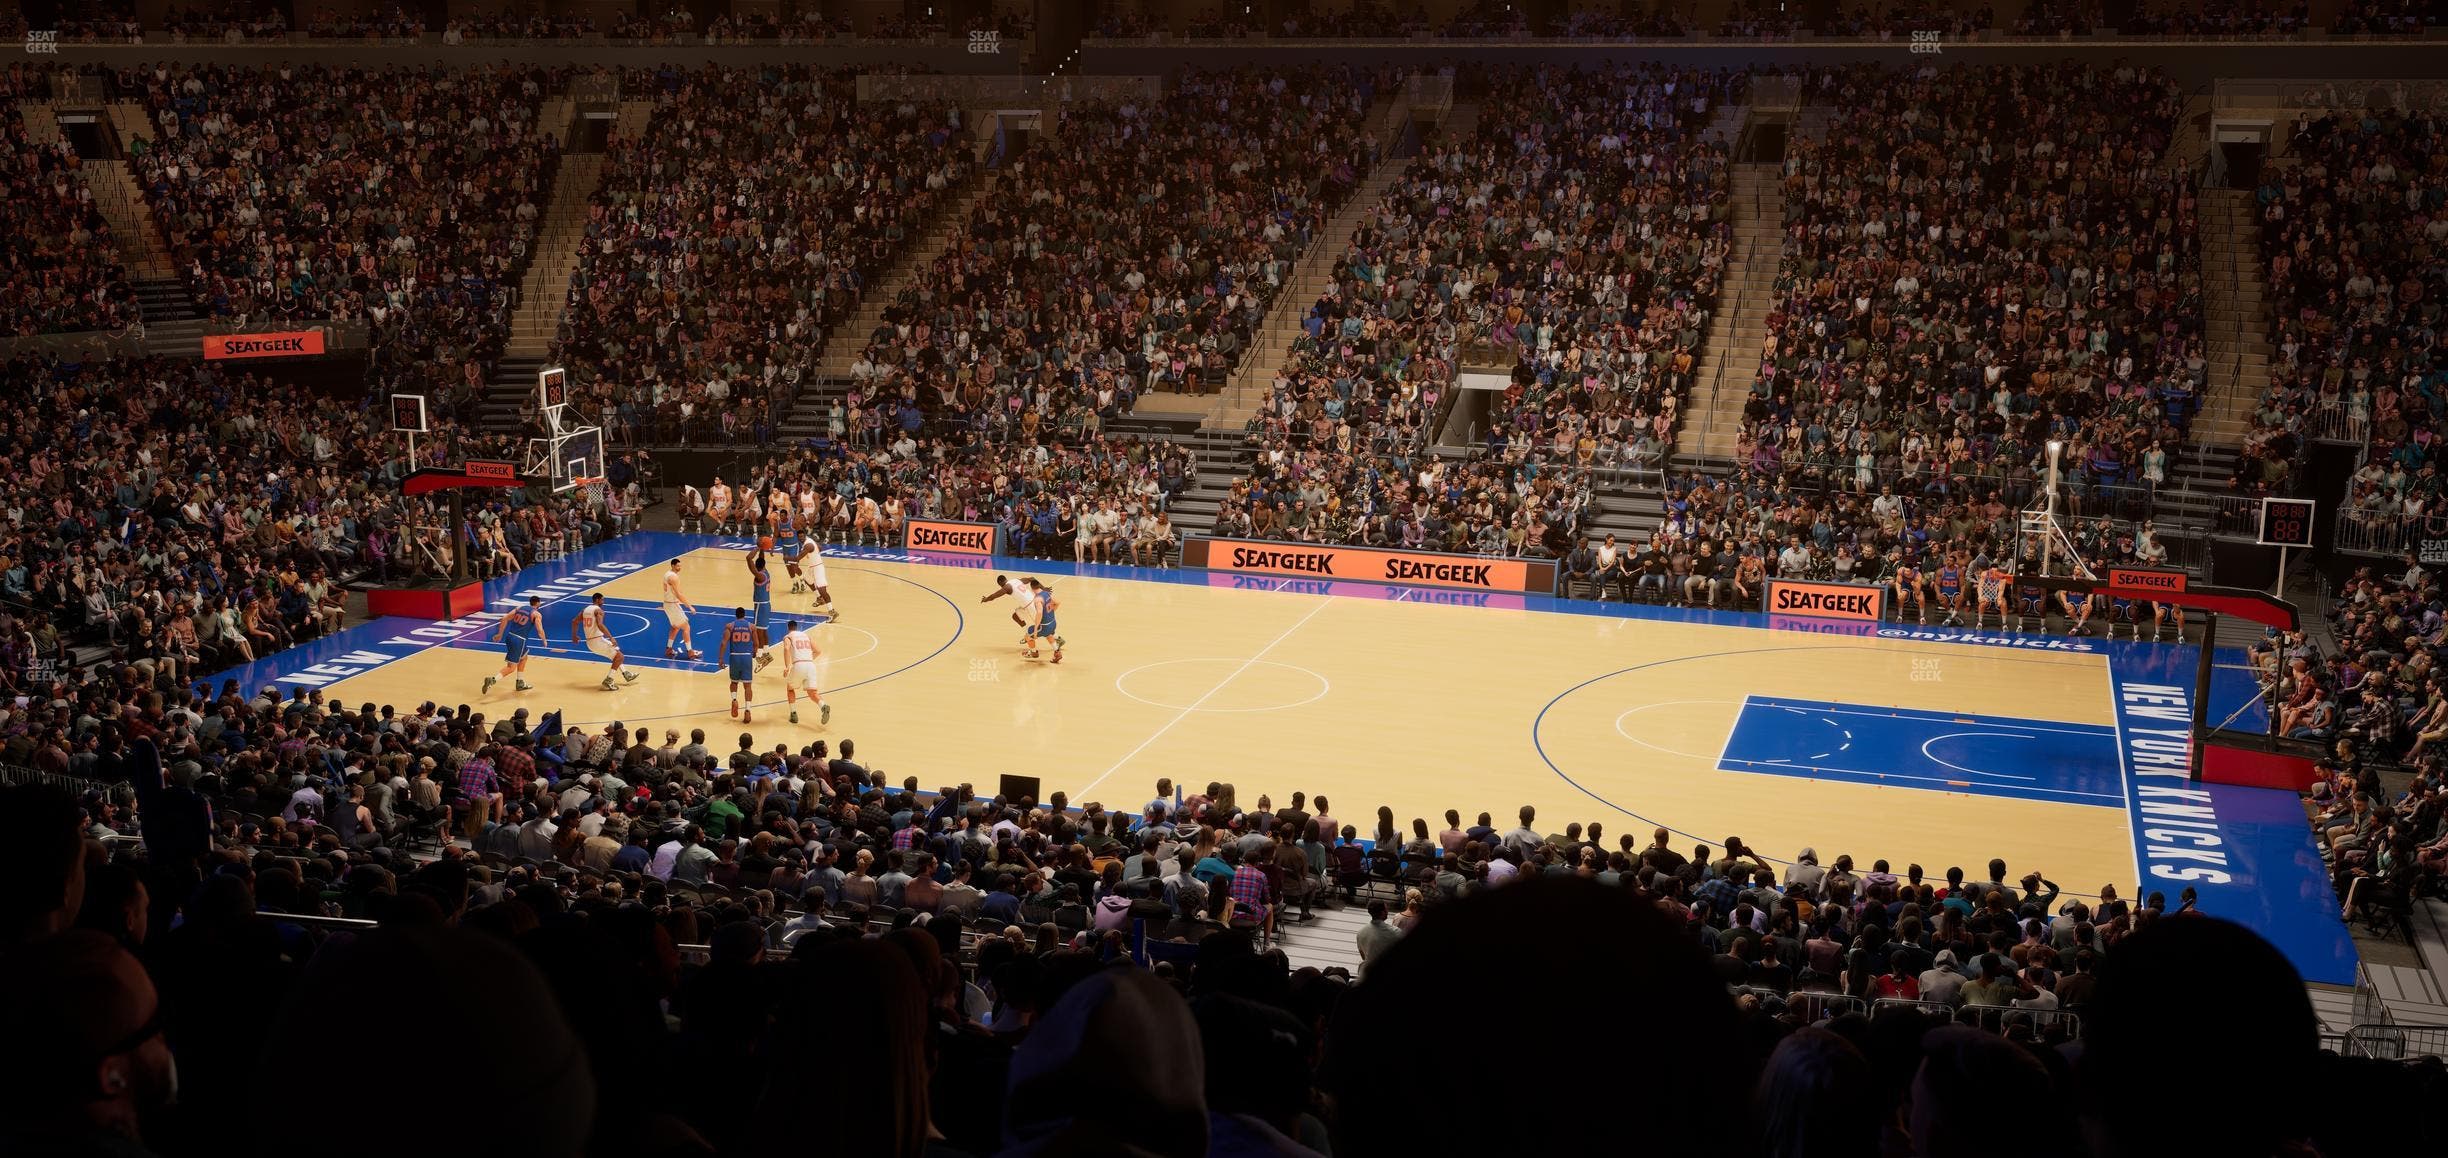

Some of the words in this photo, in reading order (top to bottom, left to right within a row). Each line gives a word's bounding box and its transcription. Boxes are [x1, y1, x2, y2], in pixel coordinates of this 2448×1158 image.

[225, 338, 304, 354] SEATGEEK
[470, 464, 510, 476] SEATGEEK
[913, 527, 988, 550] SEATGEEK
[1233, 547, 1335, 575] SEATGEEK
[1386, 558, 1491, 586] SEATGEEK
[2118, 573, 2177, 588] SEATGEEK
[1778, 588, 1873, 616] SEATGEEK
[275, 649, 397, 686] NEW
[378, 611, 509, 646] YORK
[490, 561, 644, 607] KNICKS
[732, 631, 750, 643] 00
[1877, 628, 2093, 651] @nyknicks
[2121, 682, 2192, 722] NEW
[2128, 727, 2192, 779] YORK
[2137, 785, 2232, 884] KNICKS
